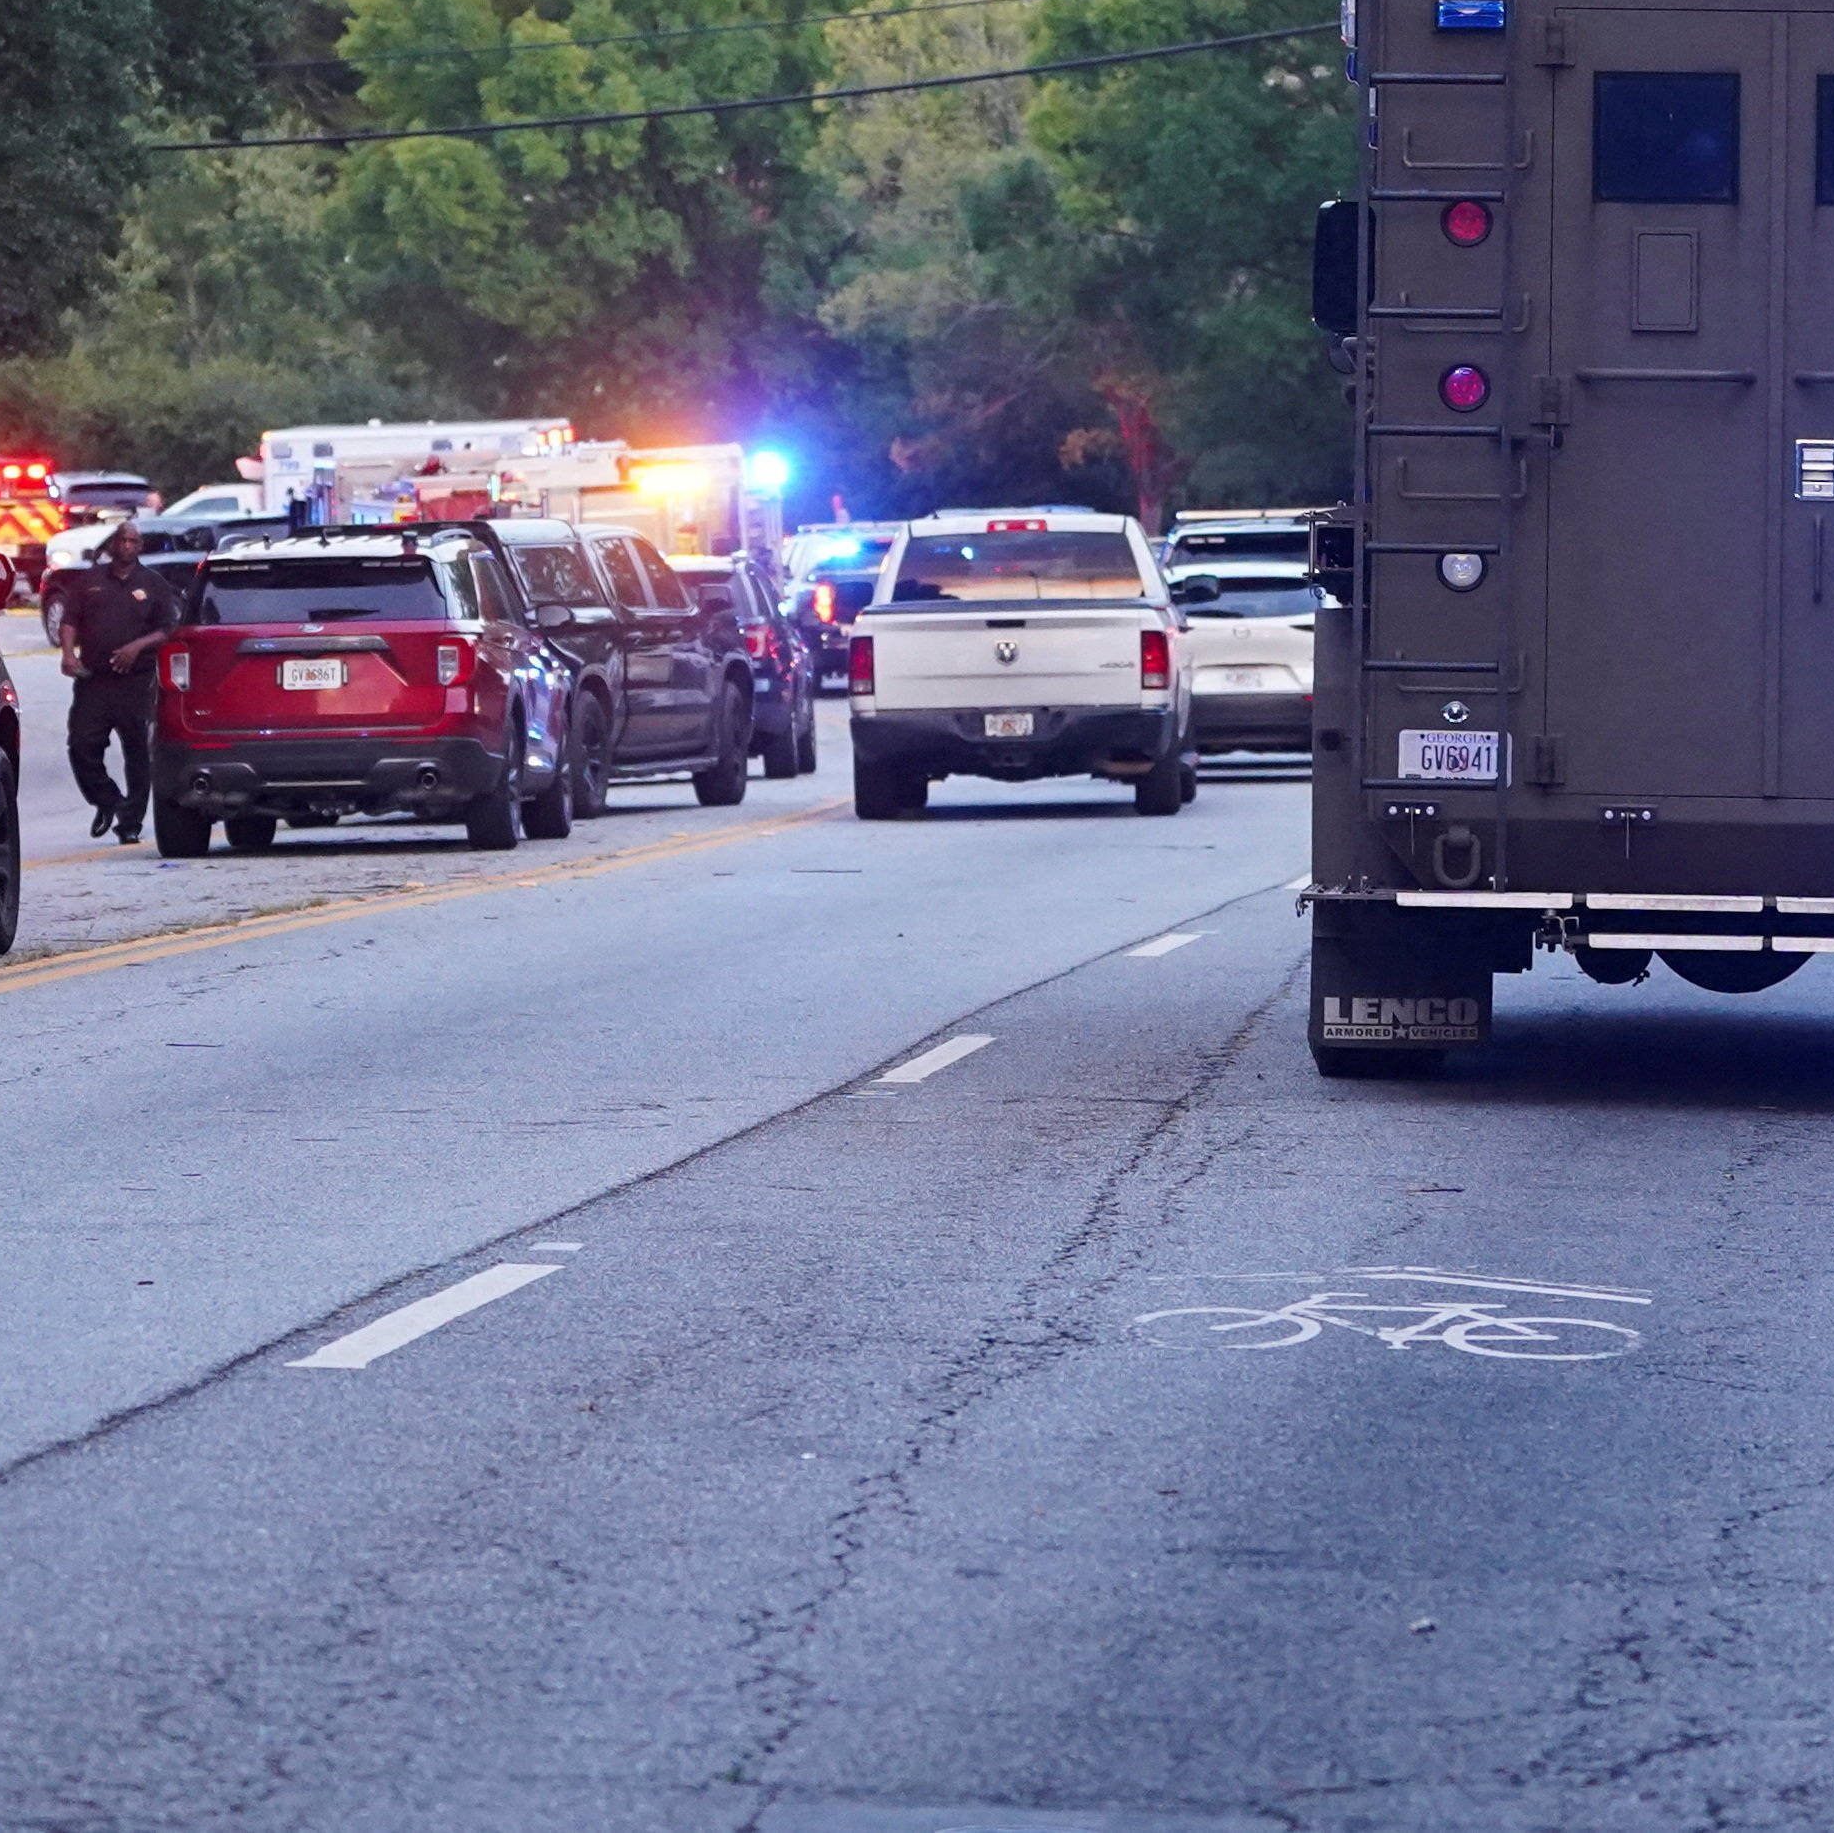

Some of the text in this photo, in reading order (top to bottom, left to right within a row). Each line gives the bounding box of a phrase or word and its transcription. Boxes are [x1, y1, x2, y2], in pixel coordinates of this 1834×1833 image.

[1427, 733, 1486, 743] GEORGIA
[1421, 745, 1491, 771] GV6941
[1324, 997, 1479, 1025] LENCO
[1325, 1027, 1478, 1038] ARMORED VEHICLES
